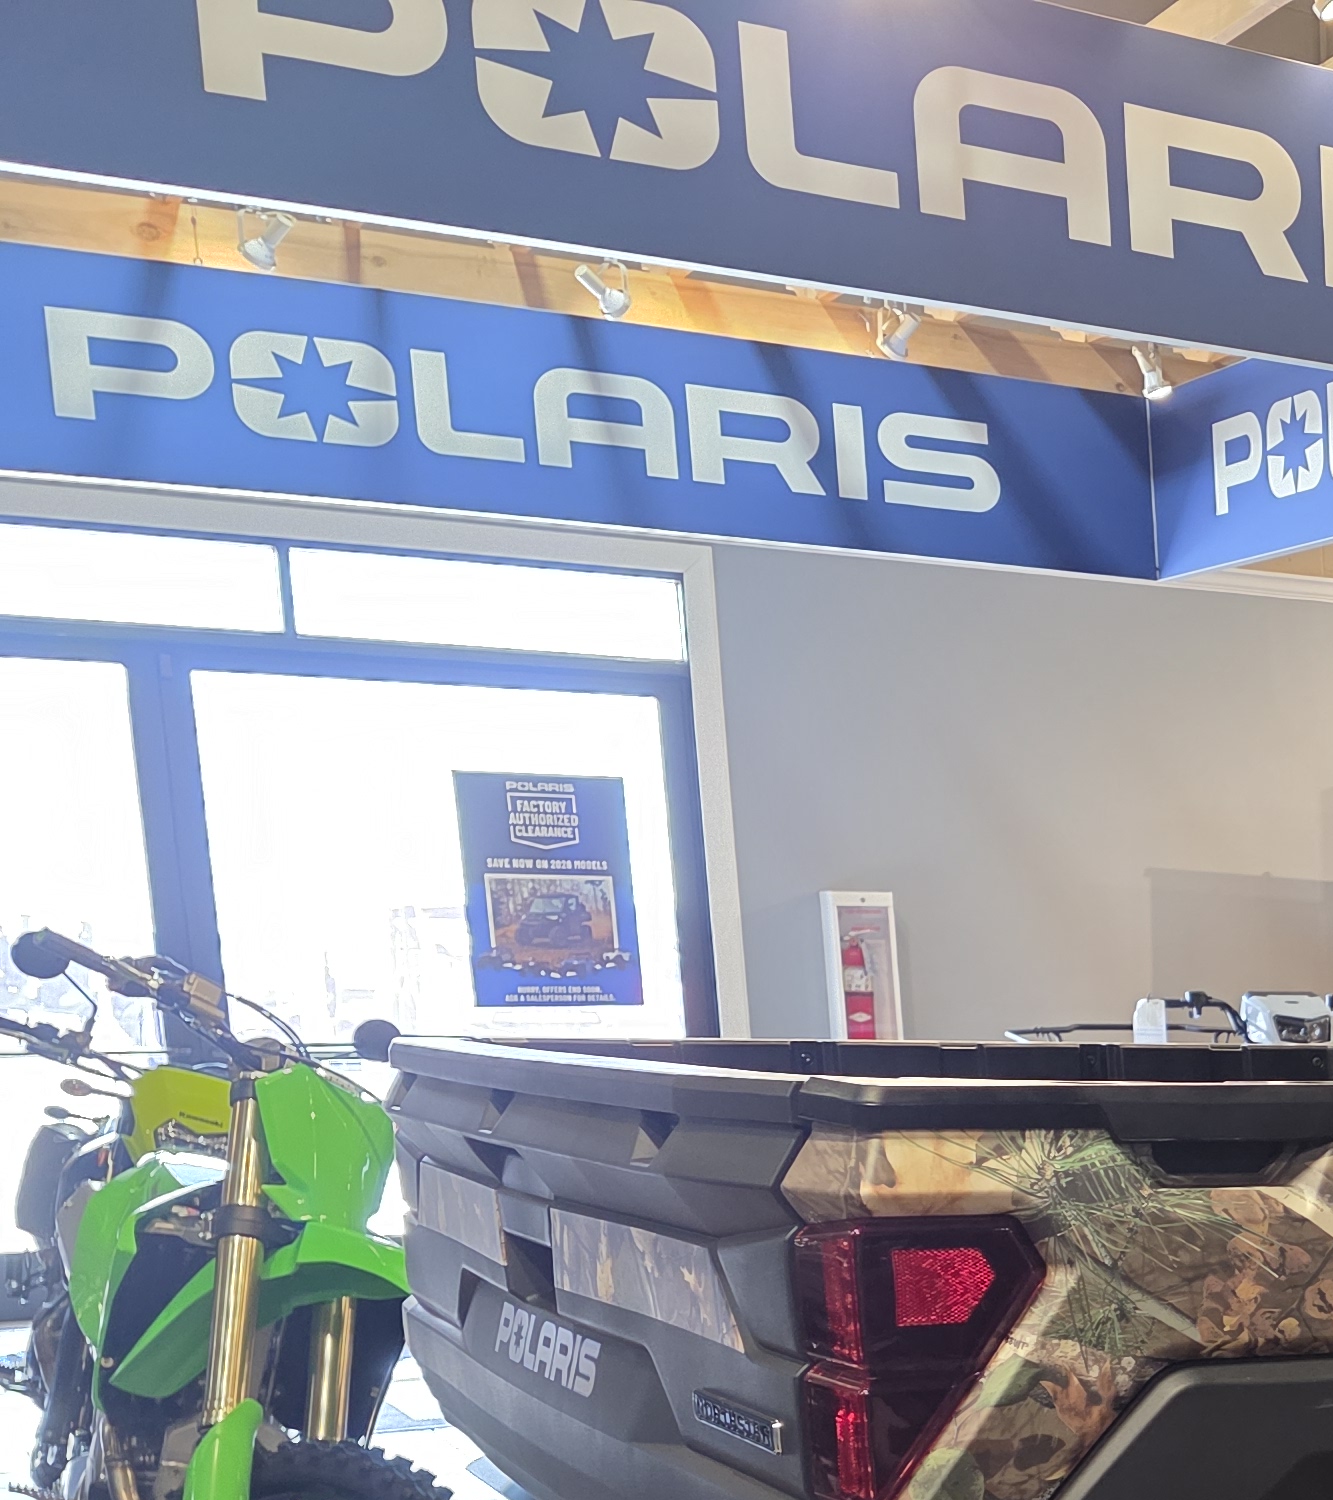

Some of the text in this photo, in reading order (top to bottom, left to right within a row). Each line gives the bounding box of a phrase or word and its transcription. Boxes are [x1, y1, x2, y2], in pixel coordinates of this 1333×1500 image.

[43, 305, 1002, 513] POLARIS
[505, 781, 575, 792] POLARIS
[516, 800, 566, 813] FACTORY
[509, 812, 579, 826] AUTHORIZED
[515, 826, 574, 838] CLEARANCE
[494, 1301, 602, 1398] POLARIS
